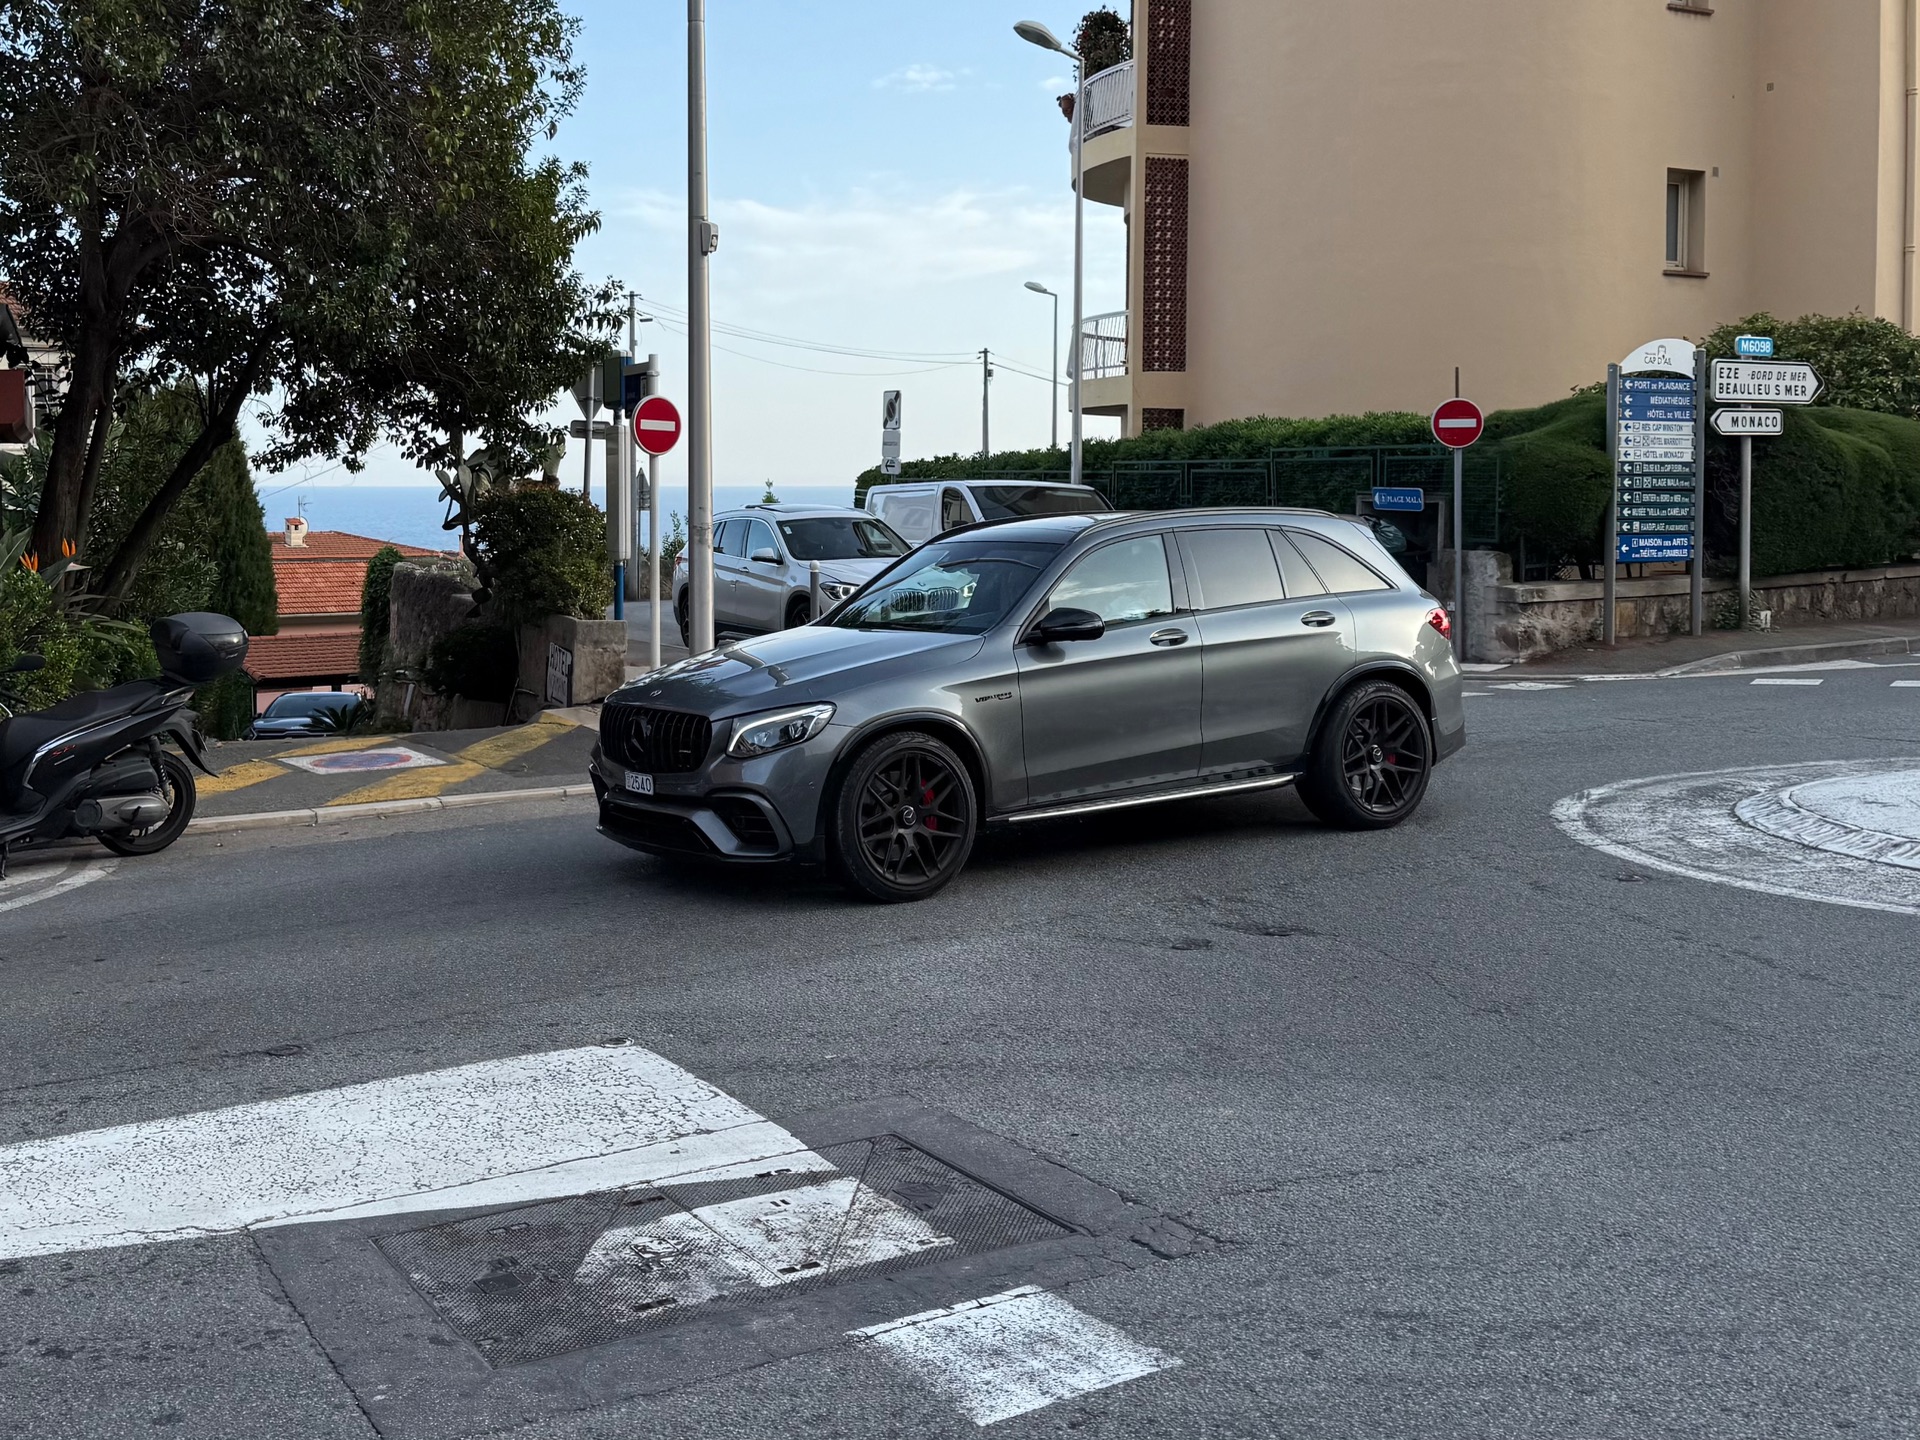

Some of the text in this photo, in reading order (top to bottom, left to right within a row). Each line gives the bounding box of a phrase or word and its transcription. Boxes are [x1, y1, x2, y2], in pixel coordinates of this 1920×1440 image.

[1741, 340, 1771, 353] M6098
[1644, 356, 1656, 365] CAP
[1719, 367, 1740, 379] EZE
[1776, 371, 1787, 381] DE
[1790, 371, 1807, 382] MER
[1634, 380, 1650, 390] PORT
[1658, 381, 1691, 391] PLAISANCE
[1718, 383, 1807, 397] BEAULIEU S MER
[1647, 409, 1666, 419] HÔTEL
[1674, 410, 1690, 419] VILLE
[1731, 416, 1778, 428] MONACO
[1650, 435, 1663, 446] HÔTEL
[1643, 448, 1658, 459] HÔTEL
[1664, 451, 1684, 460] MONACO
[1652, 478, 1667, 487] PLAGE
[1667, 478, 1679, 487] MALA
[1639, 538, 1662, 547] MAISON
[1672, 538, 1688, 546] ARTS
[630, 774, 652, 792] 2540
